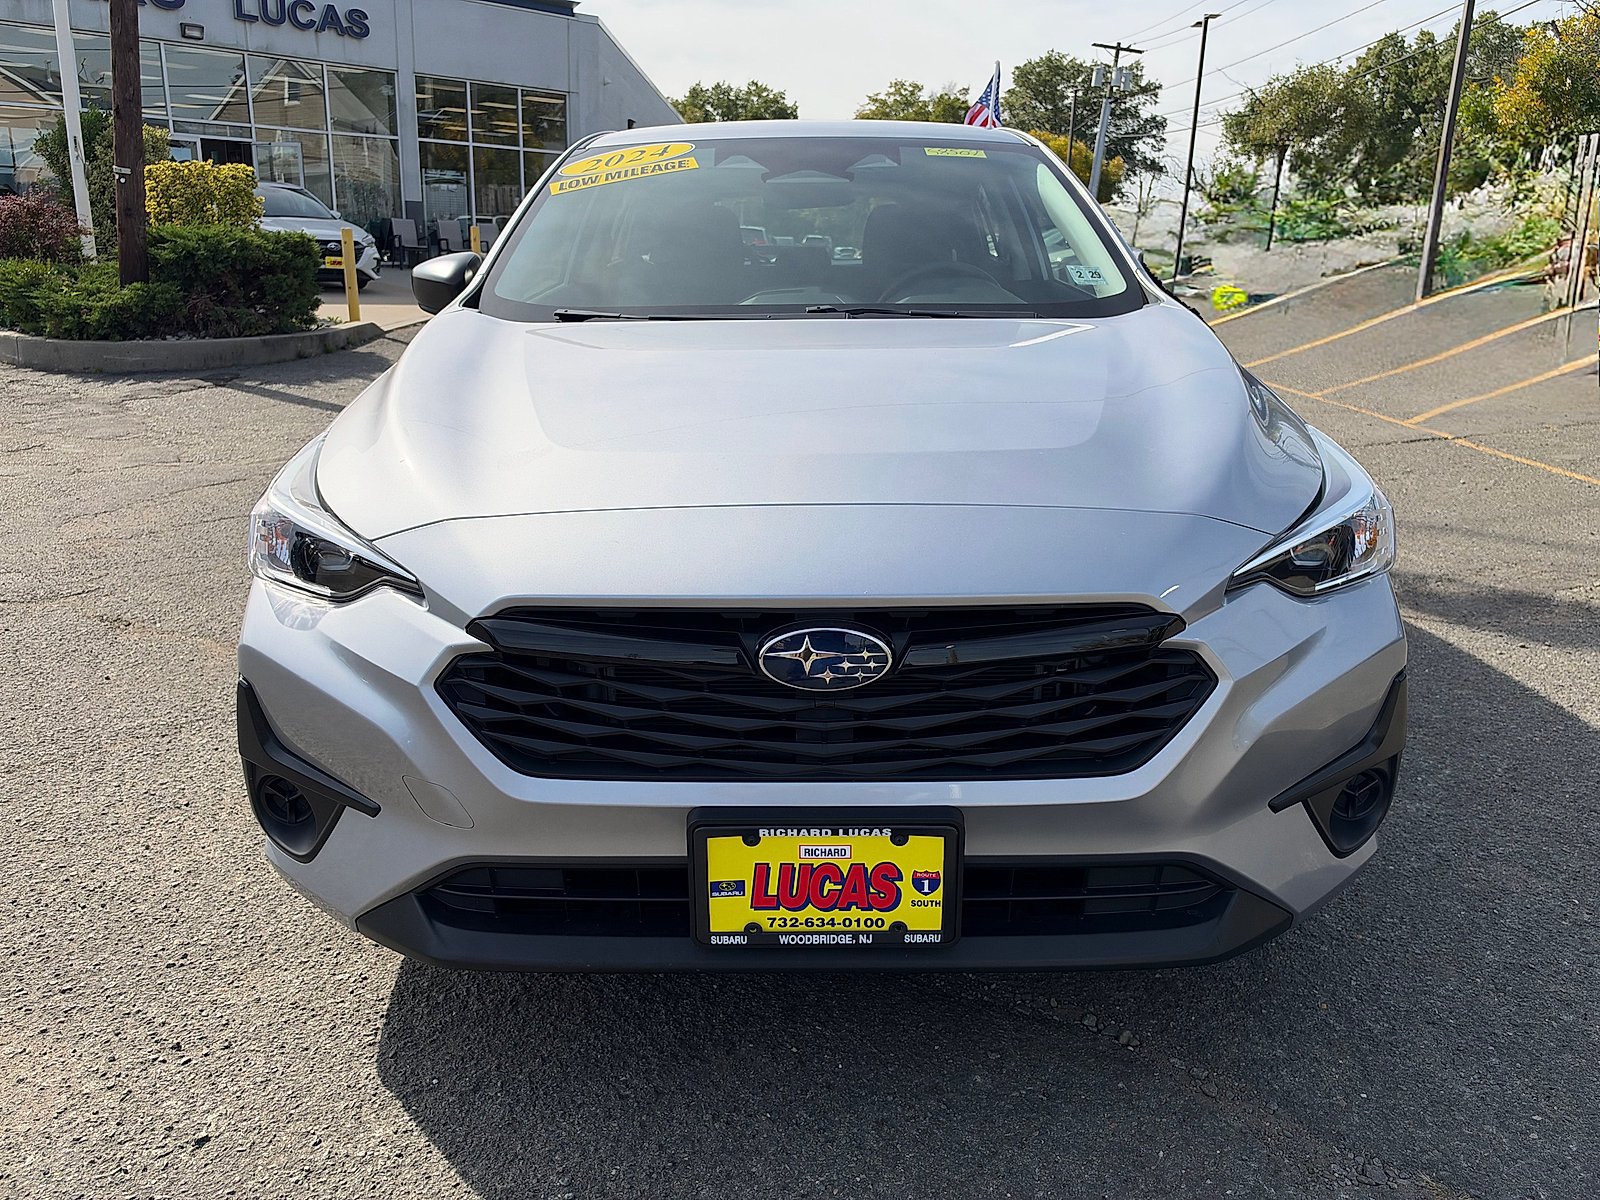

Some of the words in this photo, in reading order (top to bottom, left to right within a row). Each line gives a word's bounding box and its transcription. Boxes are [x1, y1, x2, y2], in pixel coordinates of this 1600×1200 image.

[233, 0, 371, 40] LUCAS
[581, 144, 671, 173] 2024
[558, 174, 601, 192] LOW
[604, 159, 687, 182] MILEAGE
[1076, 270, 1084, 279] 2
[758, 828, 832, 837] RICHARD
[838, 828, 892, 837] LUCAS
[803, 848, 847, 858] RICHARD
[750, 862, 903, 912] LUCAS
[921, 880, 931, 893] 1
[910, 899, 941, 908] SOUTH
[766, 917, 885, 929] 732-634-0100
[710, 935, 748, 945] SUBARU
[778, 934, 856, 945] WOODBRIDGE,
[858, 934, 873, 944] NJ
[904, 933, 941, 943] SUBARU
